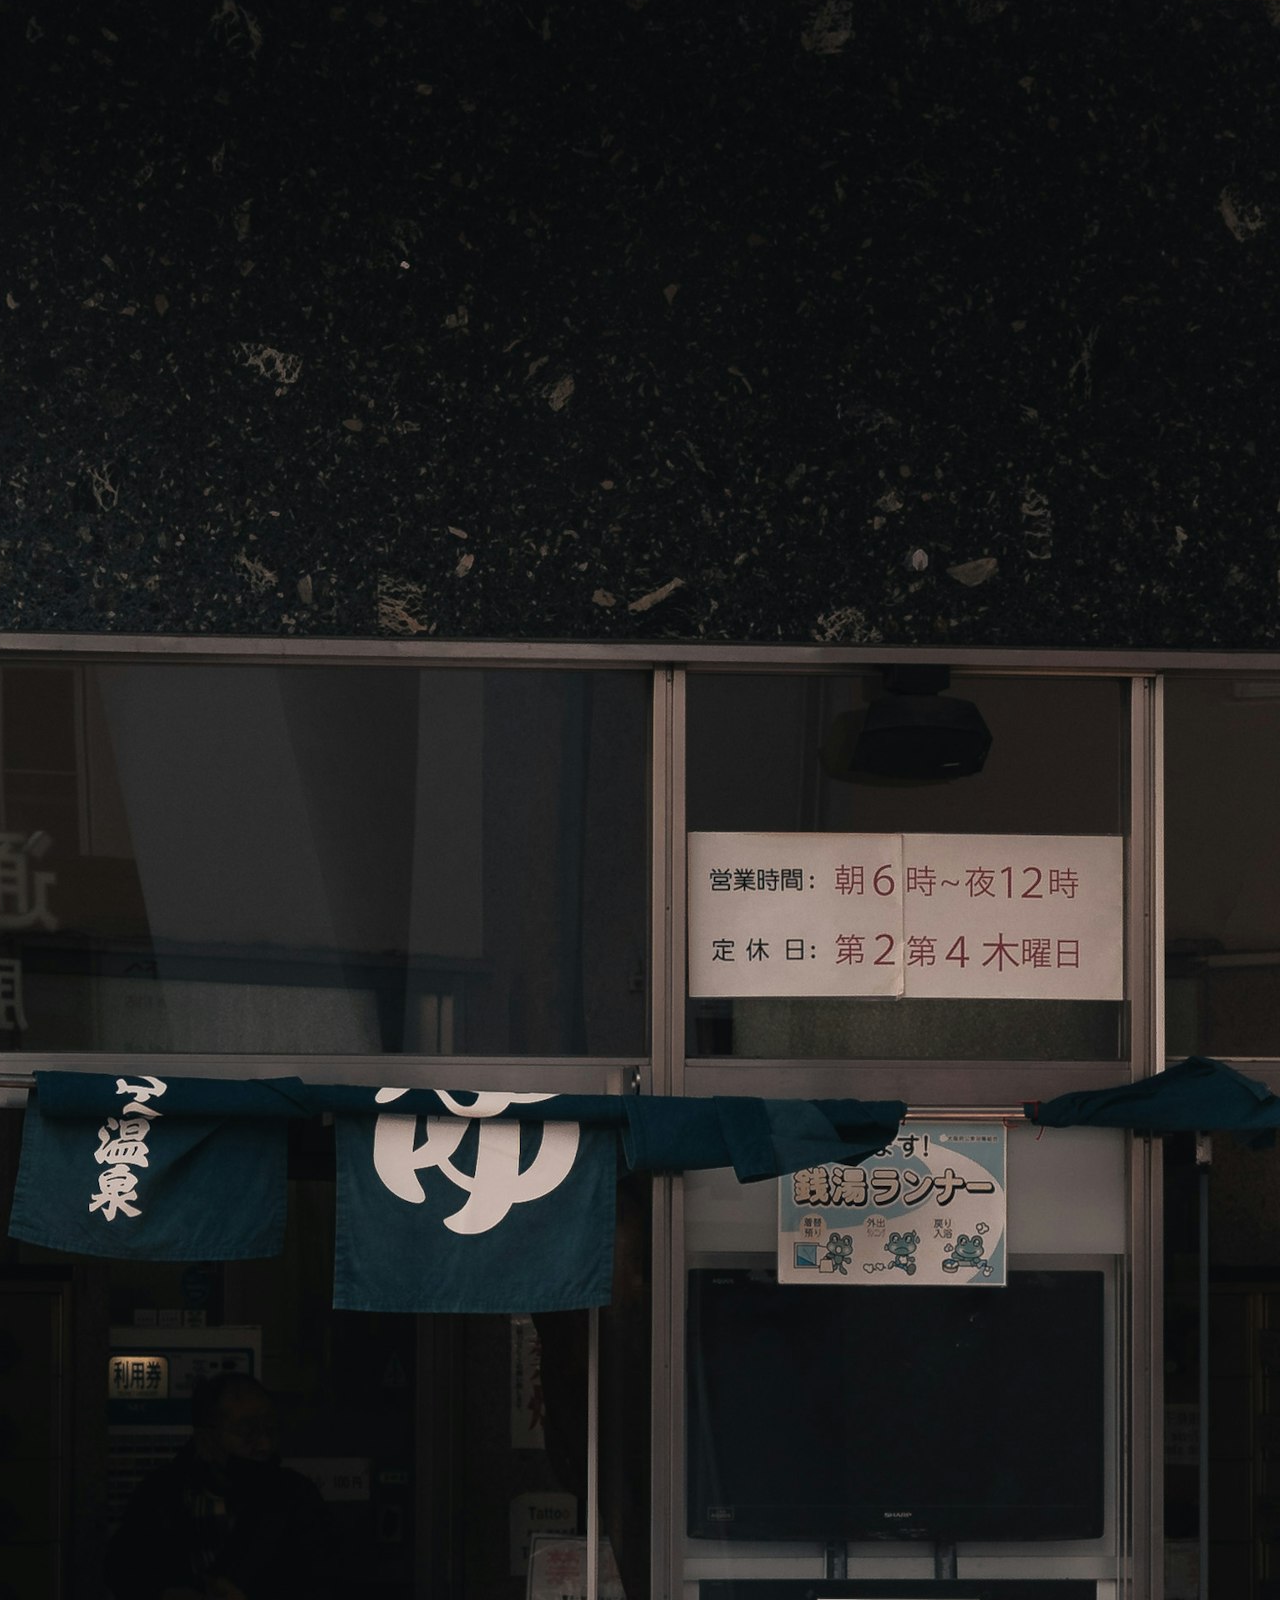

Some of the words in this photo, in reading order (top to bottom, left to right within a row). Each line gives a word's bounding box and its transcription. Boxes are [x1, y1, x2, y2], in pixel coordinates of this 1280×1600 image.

[793, 1166, 995, 1206] 銭湯ランナー
[933, 1218, 952, 1229] 戻り
[933, 1228, 952, 1239] 入浴
[113, 1361, 162, 1390] 利用券
